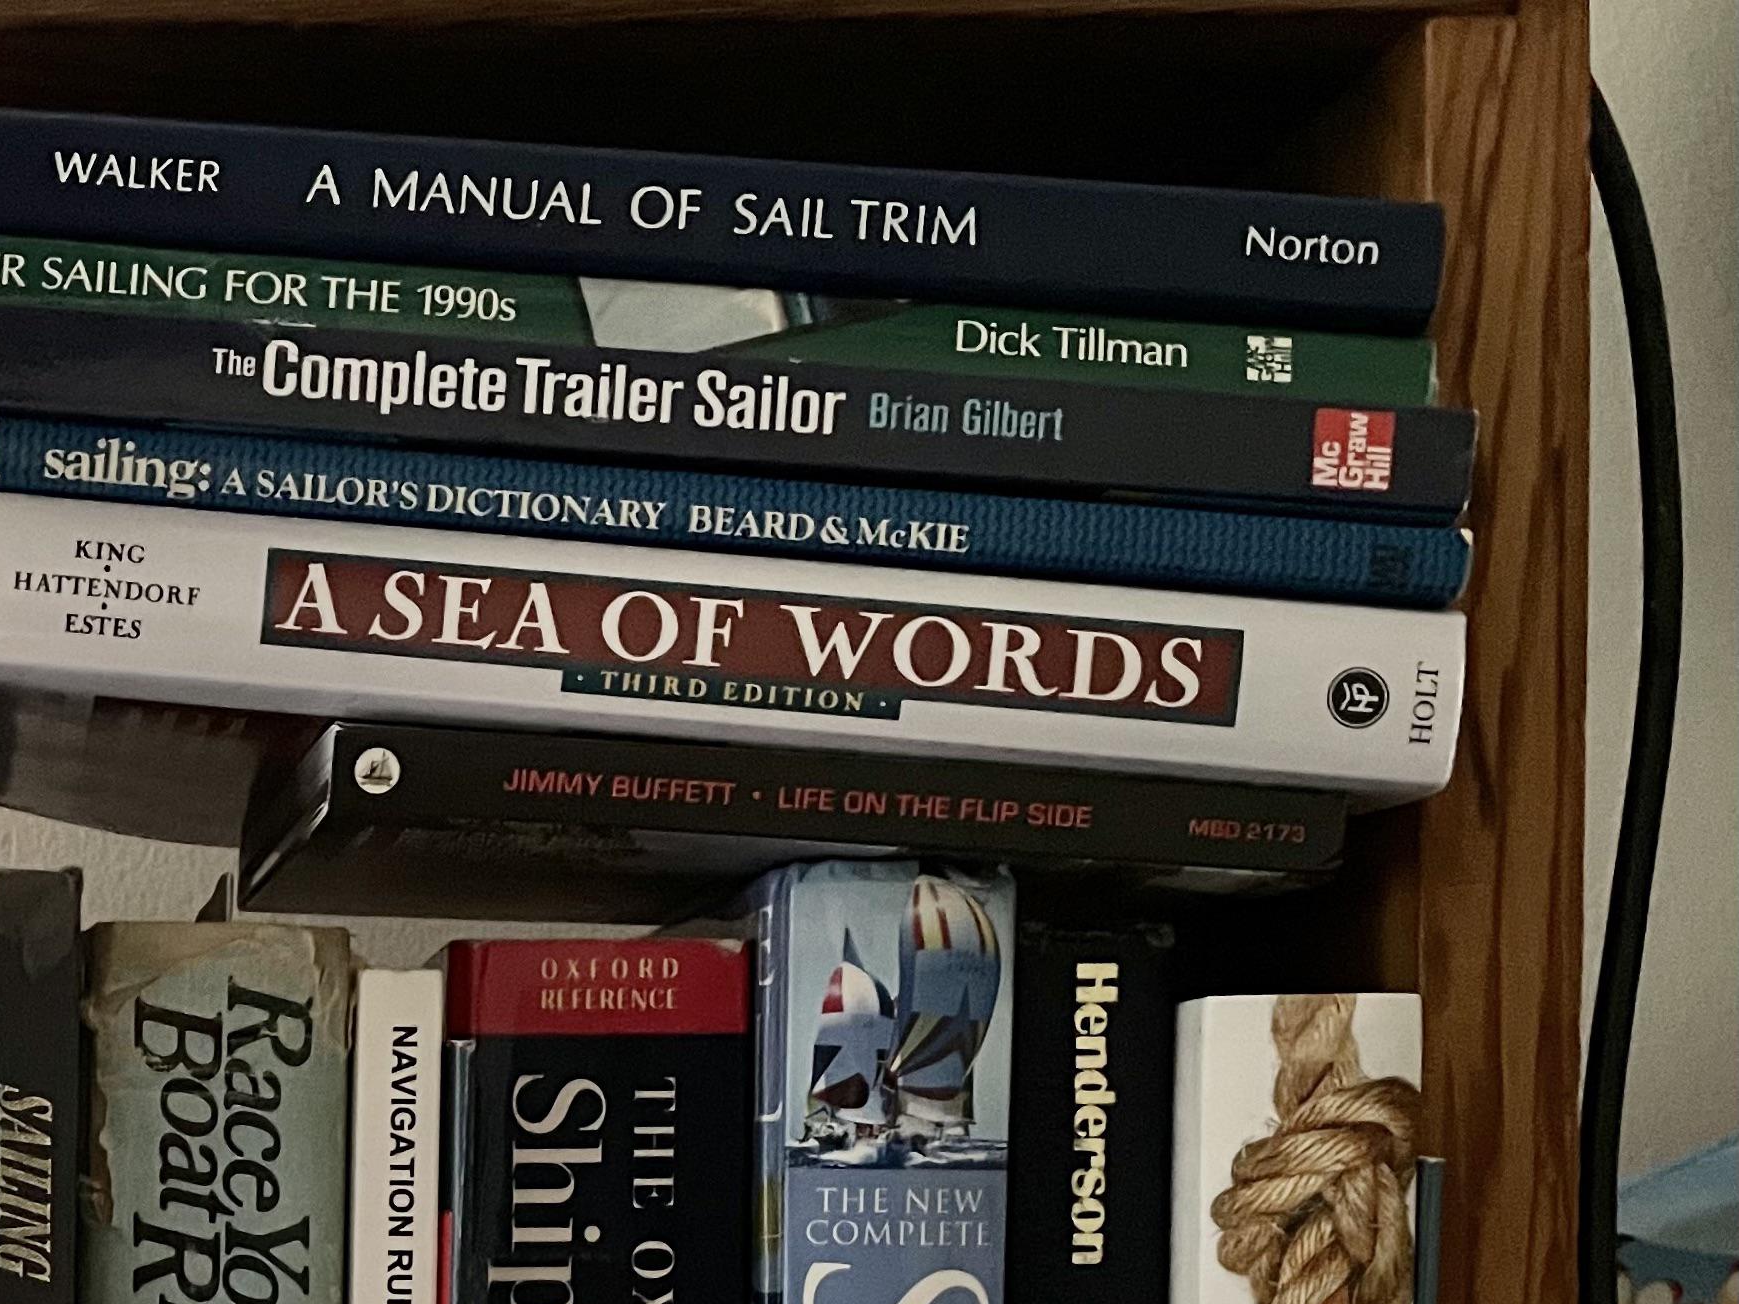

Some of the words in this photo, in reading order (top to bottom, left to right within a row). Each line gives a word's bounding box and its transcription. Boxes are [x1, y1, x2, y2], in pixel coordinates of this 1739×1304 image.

[54, 151, 220, 193] WALKER
[305, 164, 341, 206] A
[373, 167, 602, 226] MANUAL
[630, 185, 702, 230] OF
[733, 192, 834, 240] SAIL
[850, 198, 978, 247] TRIM
[1244, 225, 1380, 266] Norton
[41, 255, 208, 301] SAILING
[224, 269, 309, 308] FOR
[320, 275, 402, 314] THE
[416, 283, 517, 323] 1990s
[955, 319, 1042, 359] Dick
[1051, 325, 1188, 369] Tillman
[211, 347, 256, 379] The
[262, 338, 507, 416] Complete
[515, 356, 685, 425] Trailer
[693, 368, 847, 437] Sailor
[868, 392, 950, 435] Brian
[961, 398, 1064, 442] Gilbert
[43, 437, 211, 499] sailing:
[220, 468, 248, 497] A
[256, 470, 418, 514] SAILOR'S
[426, 483, 666, 531] DICTIONARY
[74, 539, 146, 564] KING
[688, 504, 816, 545] BEARD
[858, 517, 971, 555] McKIE
[13, 570, 201, 607] HATTENDORF
[64, 612, 142, 640] ESTES
[274, 561, 348, 636] A
[368, 569, 570, 655] SEA
[600, 589, 745, 669] OF
[779, 602, 1205, 709] WORDS
[600, 670, 708, 700] THIRD
[723, 680, 864, 712] EDITION
[1407, 659, 1441, 747] HOLT
[503, 768, 603, 797] JIMMY
[612, 776, 736, 807] BUFFETT
[778, 786, 834, 813] LIFE
[843, 791, 886, 815] ON
[895, 793, 950, 820] THE
[960, 799, 1019, 826] FLIP
[1026, 803, 1093, 829] SIDE
[541, 957, 679, 981] OXFORD
[540, 988, 680, 1012] REFERENCE
[134, 996, 225, 1224] Boat
[224, 975, 314, 1214] Race
[1071, 962, 1120, 1265] Henderson
[388, 1025, 418, 1237] NAVIGATION
[632, 1076, 676, 1210] THE
[815, 1186, 889, 1215] THE
[904, 1187, 983, 1215] NEW
[805, 1218, 991, 1248] COMPLETE
